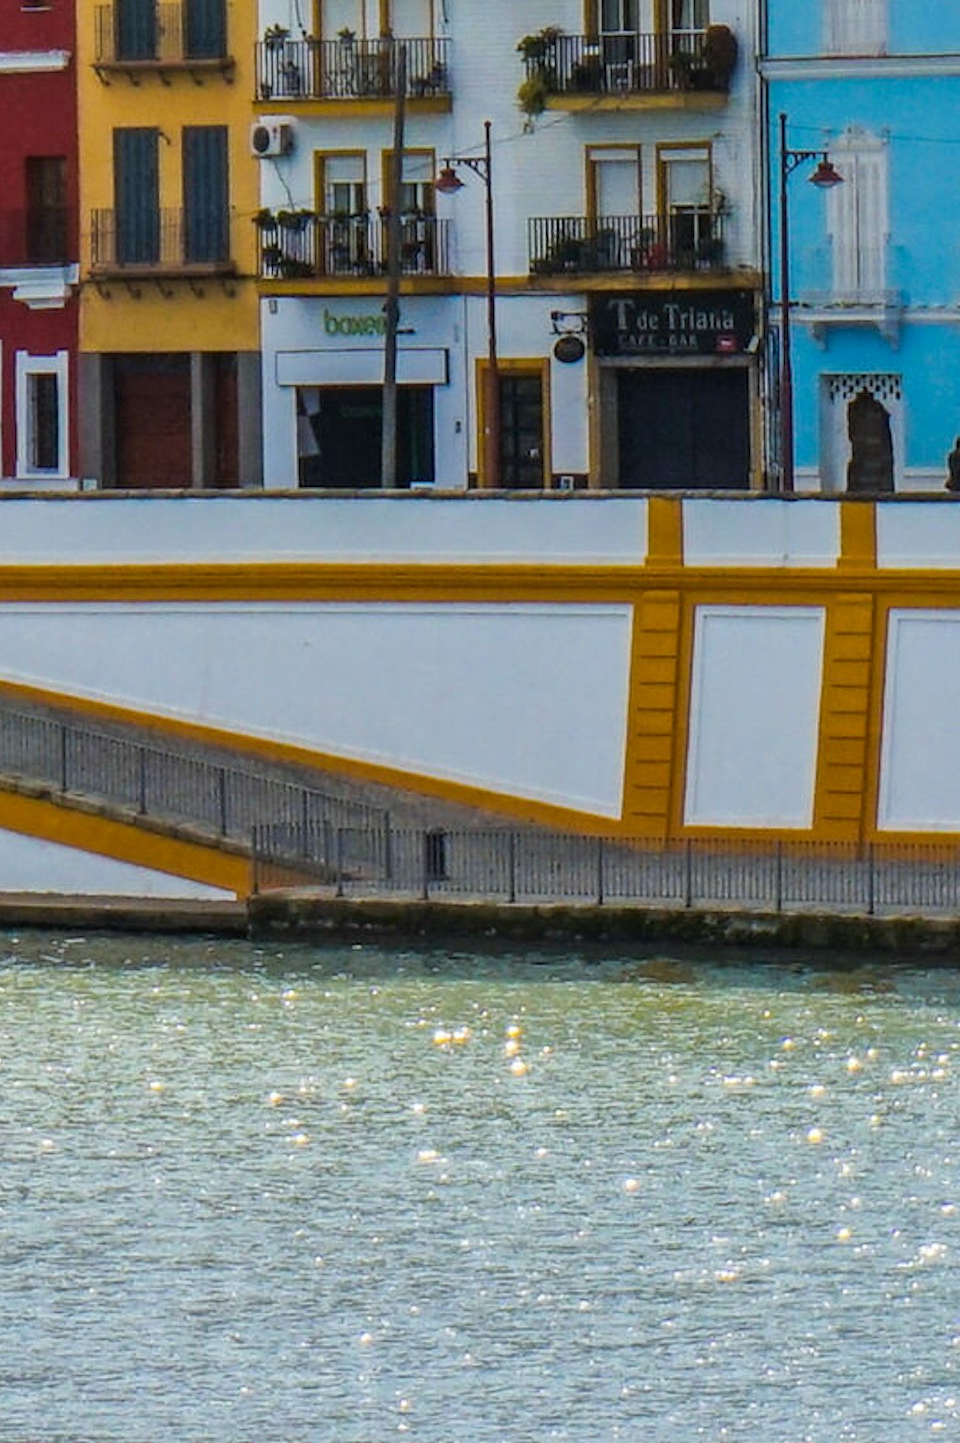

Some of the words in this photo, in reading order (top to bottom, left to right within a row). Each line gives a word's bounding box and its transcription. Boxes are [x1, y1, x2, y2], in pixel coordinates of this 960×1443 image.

[608, 298, 635, 330] T
[636, 310, 659, 330] de
[663, 303, 735, 330] Triana
